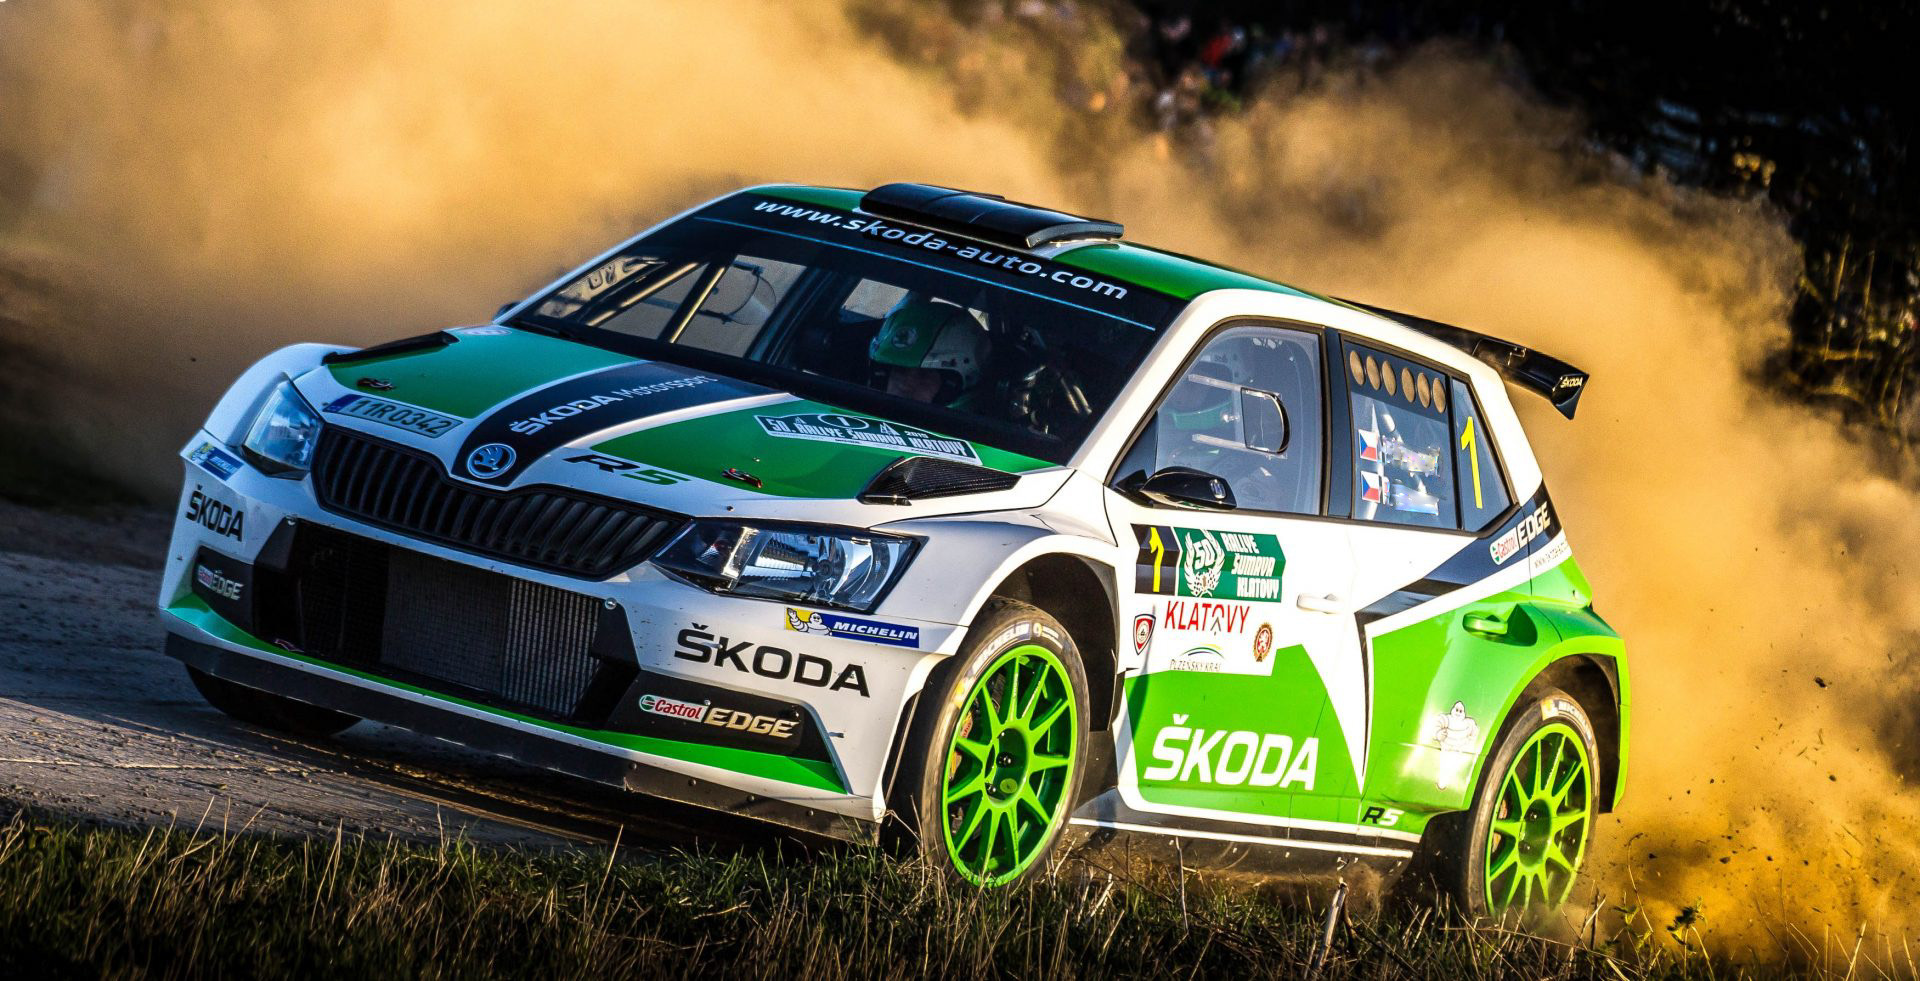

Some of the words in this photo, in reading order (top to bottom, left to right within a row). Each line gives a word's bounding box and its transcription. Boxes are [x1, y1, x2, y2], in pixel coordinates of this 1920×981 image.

[753, 200, 1129, 300] www.skoda-auto.com
[509, 394, 624, 436] ŠKODA
[610, 374, 719, 399] Motorsport
[793, 422, 845, 439] RALLYE
[562, 454, 692, 486] R5
[1461, 416, 1483, 509] 1
[185, 484, 245, 542] ŠKODA
[1517, 500, 1551, 549] EDGE
[1149, 526, 1165, 593] 1
[1192, 538, 1215, 571] 50
[1220, 532, 1260, 554] RALLYE
[211, 573, 245, 601] EDGE
[1236, 576, 1280, 599] KLATOVY
[833, 621, 918, 640] MICHELIN
[1164, 600, 1250, 635] KLATOVY
[674, 622, 871, 698] ŠKODA
[654, 699, 703, 720] Castrol
[703, 707, 800, 738] EDGE
[1143, 713, 1319, 791] ŠKODA
[1361, 806, 1405, 827] R5
